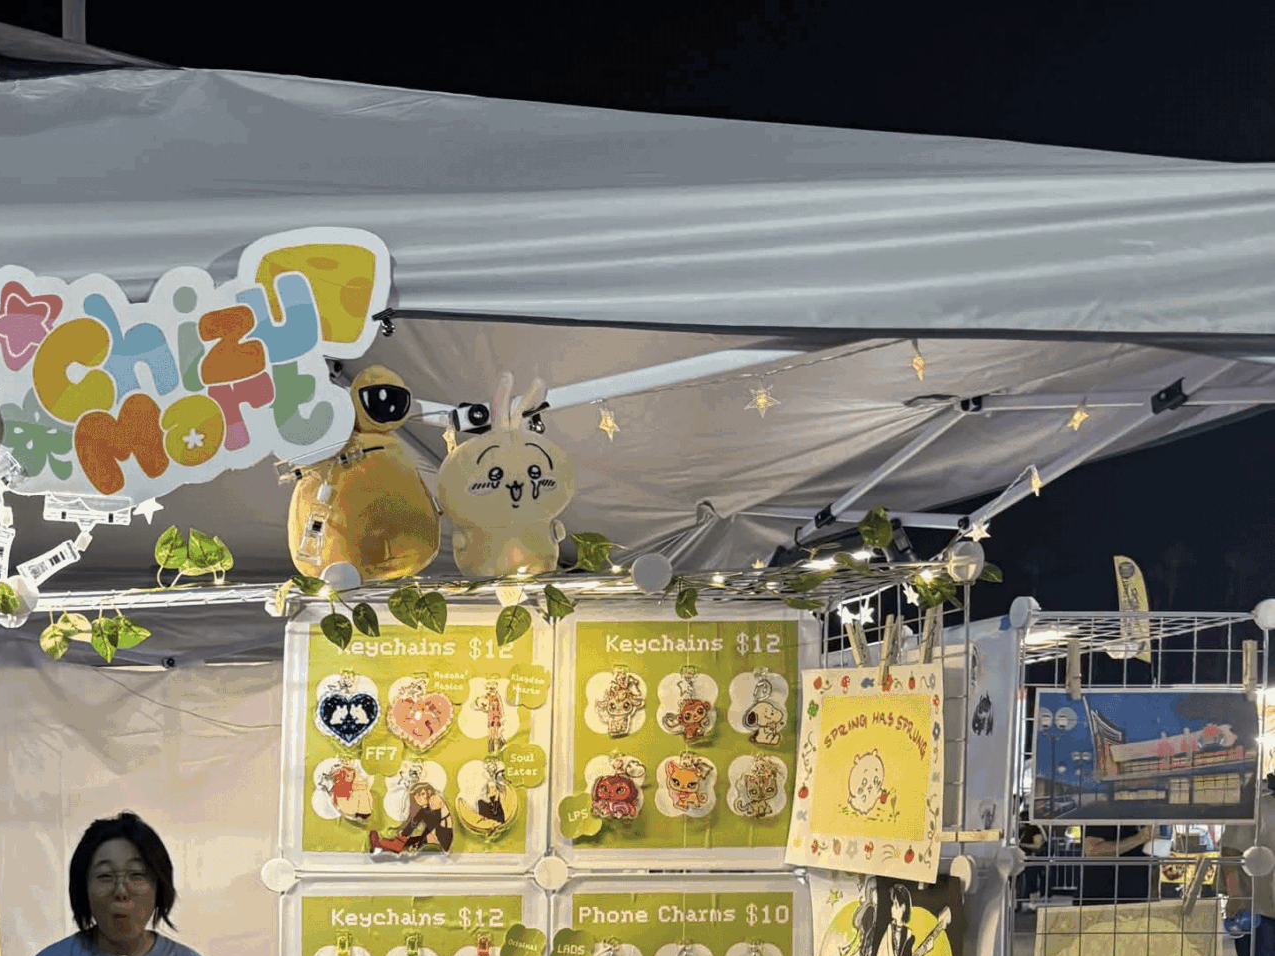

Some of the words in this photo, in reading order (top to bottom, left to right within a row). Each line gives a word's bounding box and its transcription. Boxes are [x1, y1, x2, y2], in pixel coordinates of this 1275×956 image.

[33, 271, 320, 424] Chizu
[74, 362, 335, 495] Mart
[337, 638, 456, 657] eychains
[468, 636, 514, 661] $12
[606, 634, 724, 655] Keychains
[735, 631, 781, 655] $12
[823, 713, 868, 749] SPRING
[871, 711, 894, 727] HAS
[895, 714, 928, 762] SPRUNG
[364, 745, 398, 761] FF7
[509, 752, 535, 764] Soul
[506, 765, 538, 777] Eater
[567, 808, 589, 822] LPS
[331, 908, 446, 927] Keychains
[458, 906, 504, 929] $12
[578, 905, 649, 924] Phone
[657, 904, 736, 923] Charms
[745, 902, 790, 926] $10
[557, 943, 586, 955] LADS
